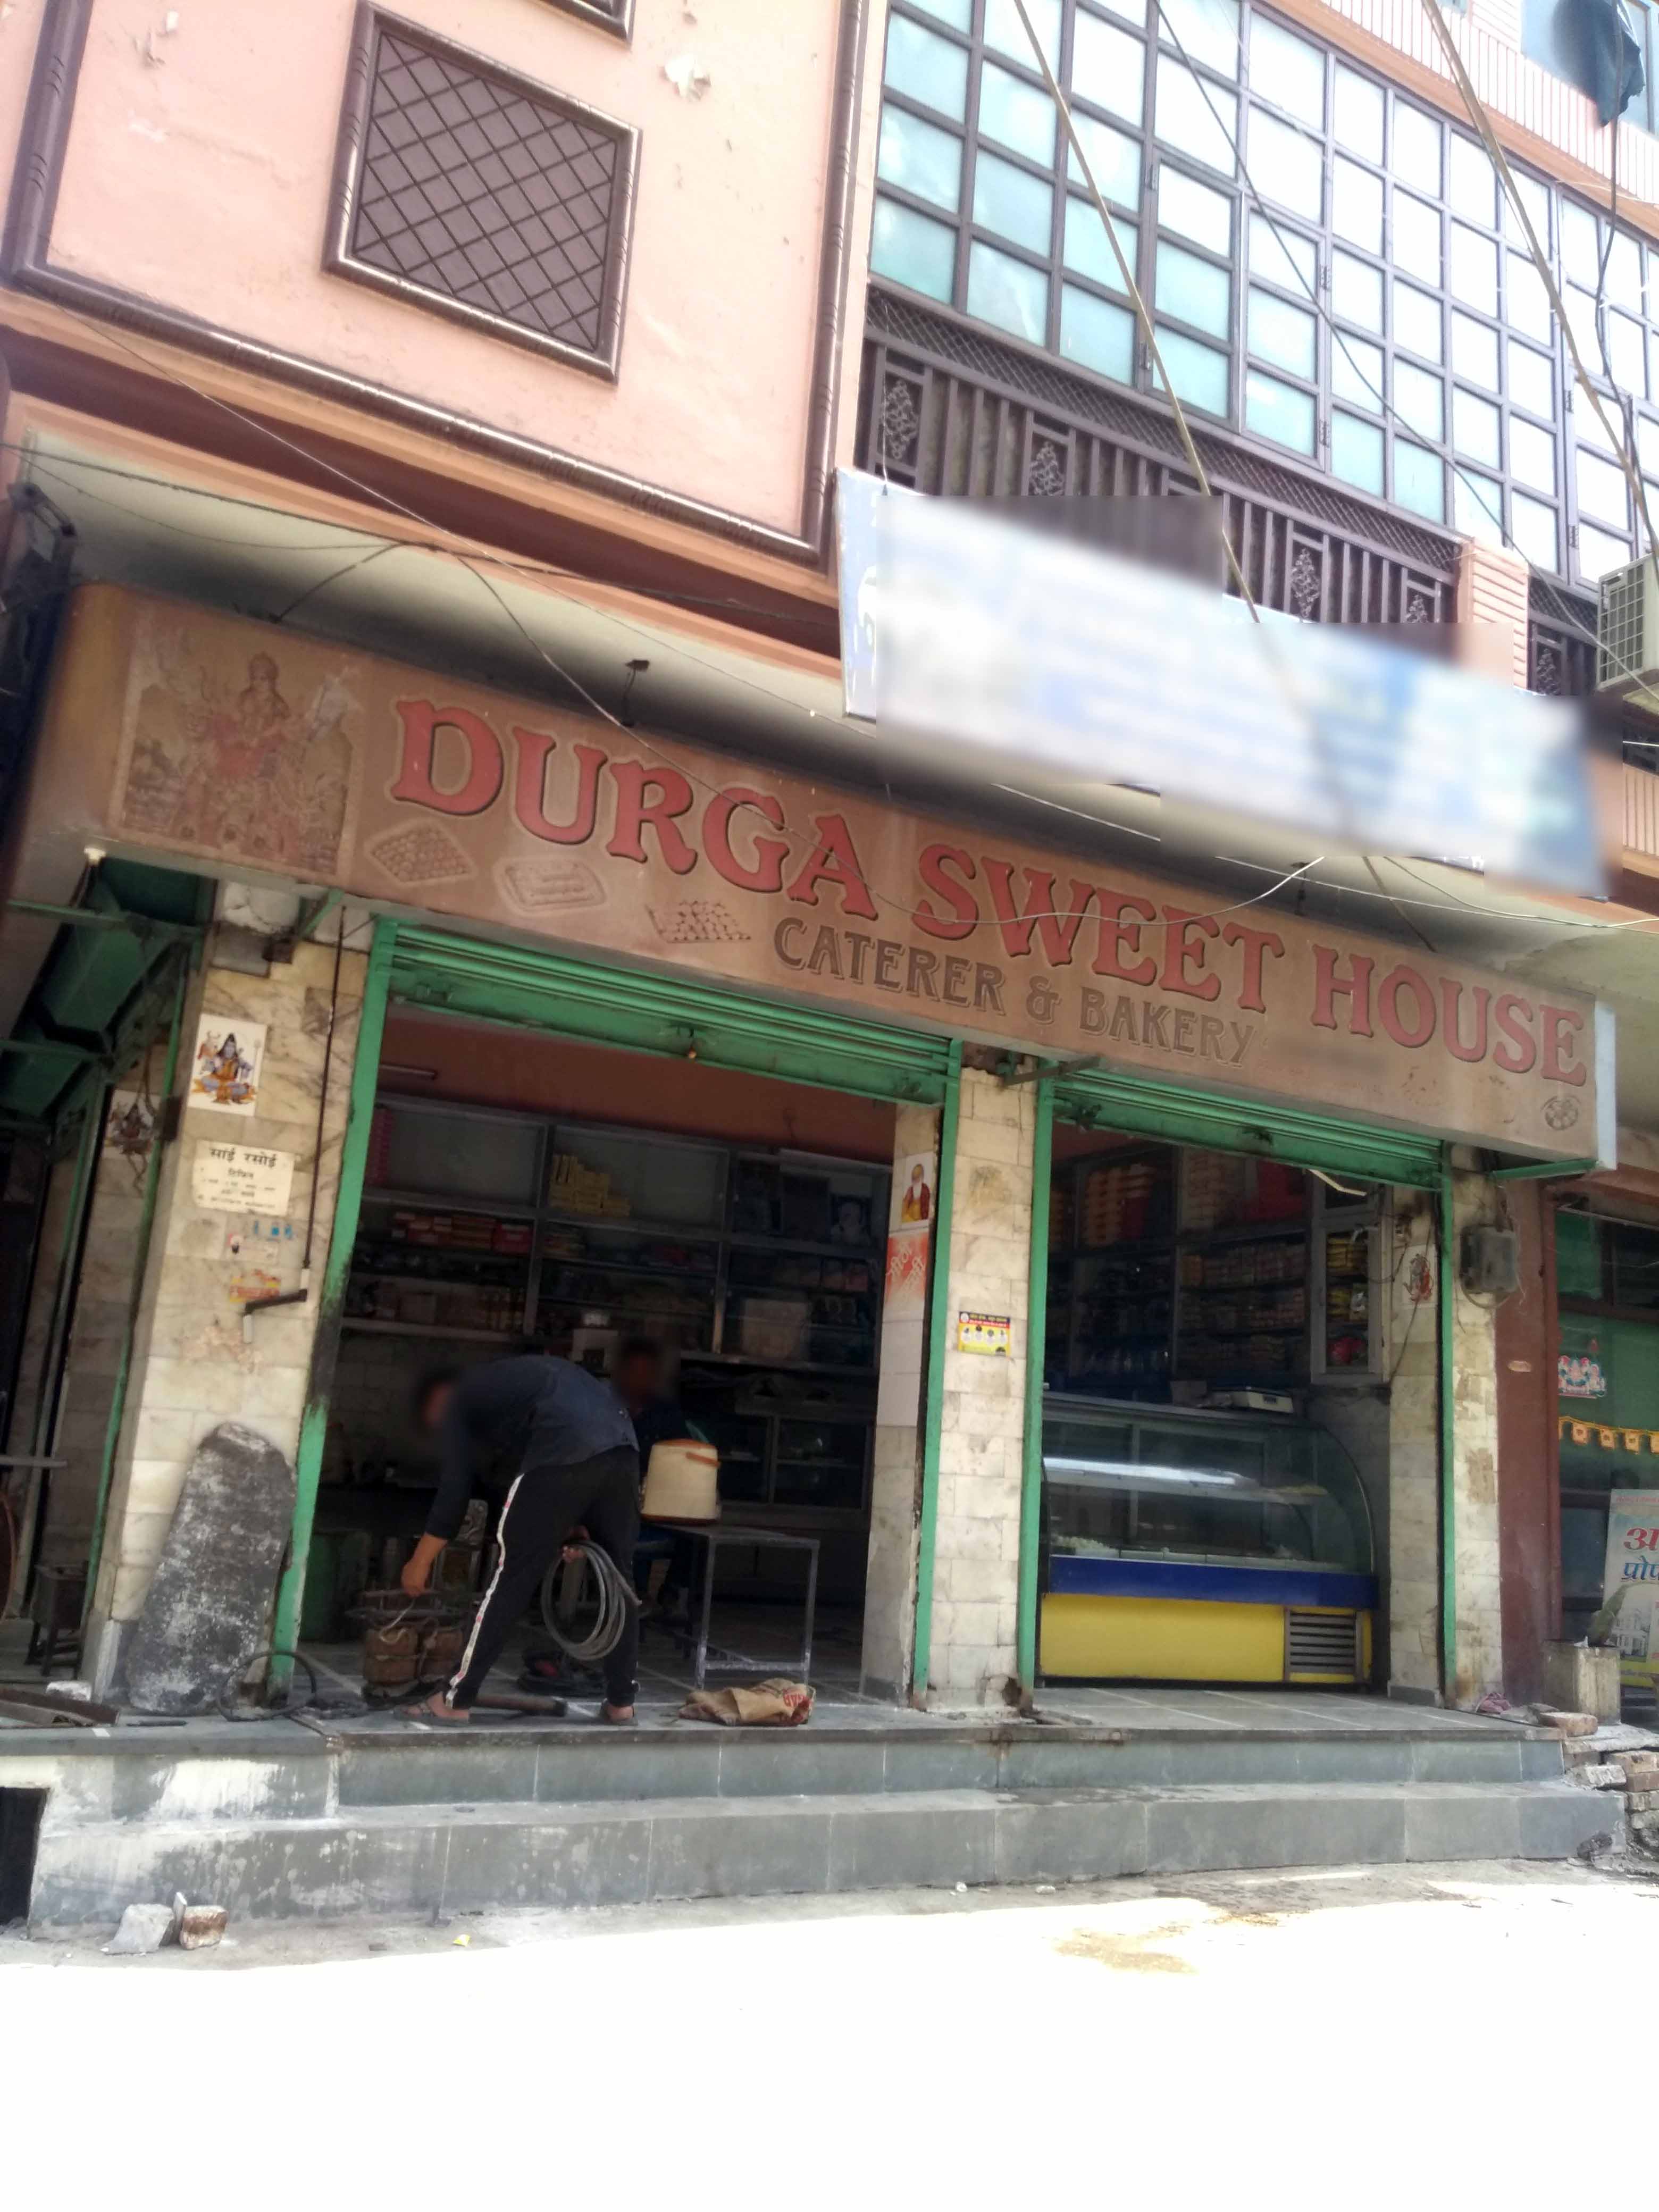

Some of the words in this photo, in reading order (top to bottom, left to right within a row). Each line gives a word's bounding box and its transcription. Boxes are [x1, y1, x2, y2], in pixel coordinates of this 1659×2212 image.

[390, 700, 878, 921] DURGA
[911, 843, 1285, 1013] SWEET
[1310, 943, 1587, 1087] HOUSE
[774, 916, 1006, 1016] CATERER
[1026, 976, 1060, 1024] &
[1079, 986, 1255, 1067] BAKERY
[244, 1151, 276, 1168] रसोई
